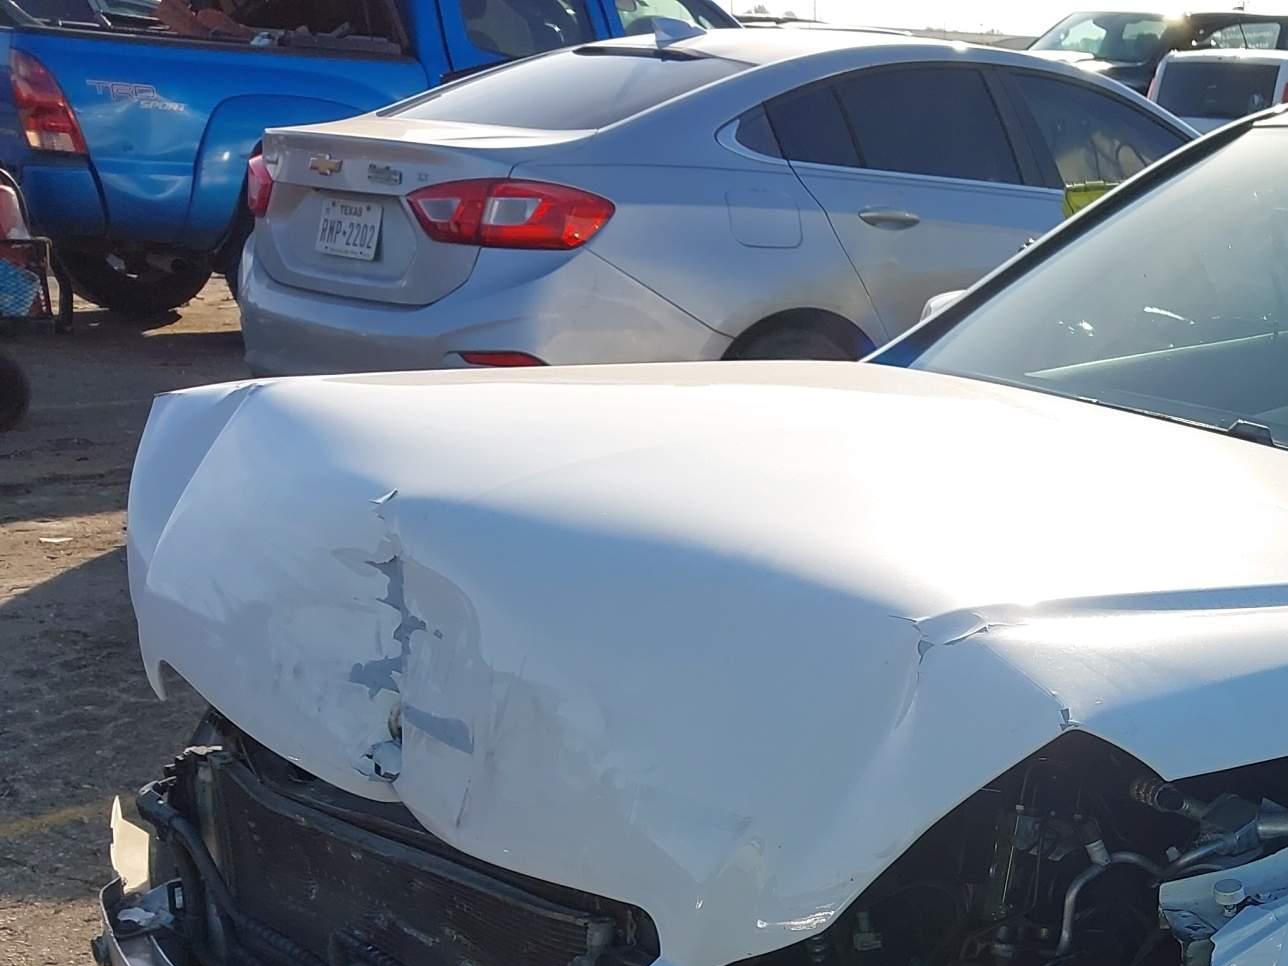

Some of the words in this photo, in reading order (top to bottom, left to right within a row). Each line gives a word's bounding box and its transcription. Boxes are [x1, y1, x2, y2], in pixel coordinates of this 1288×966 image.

[86, 79, 156, 102] TRD
[140, 100, 185, 112] SPORT
[340, 204, 363, 217] TEXAS
